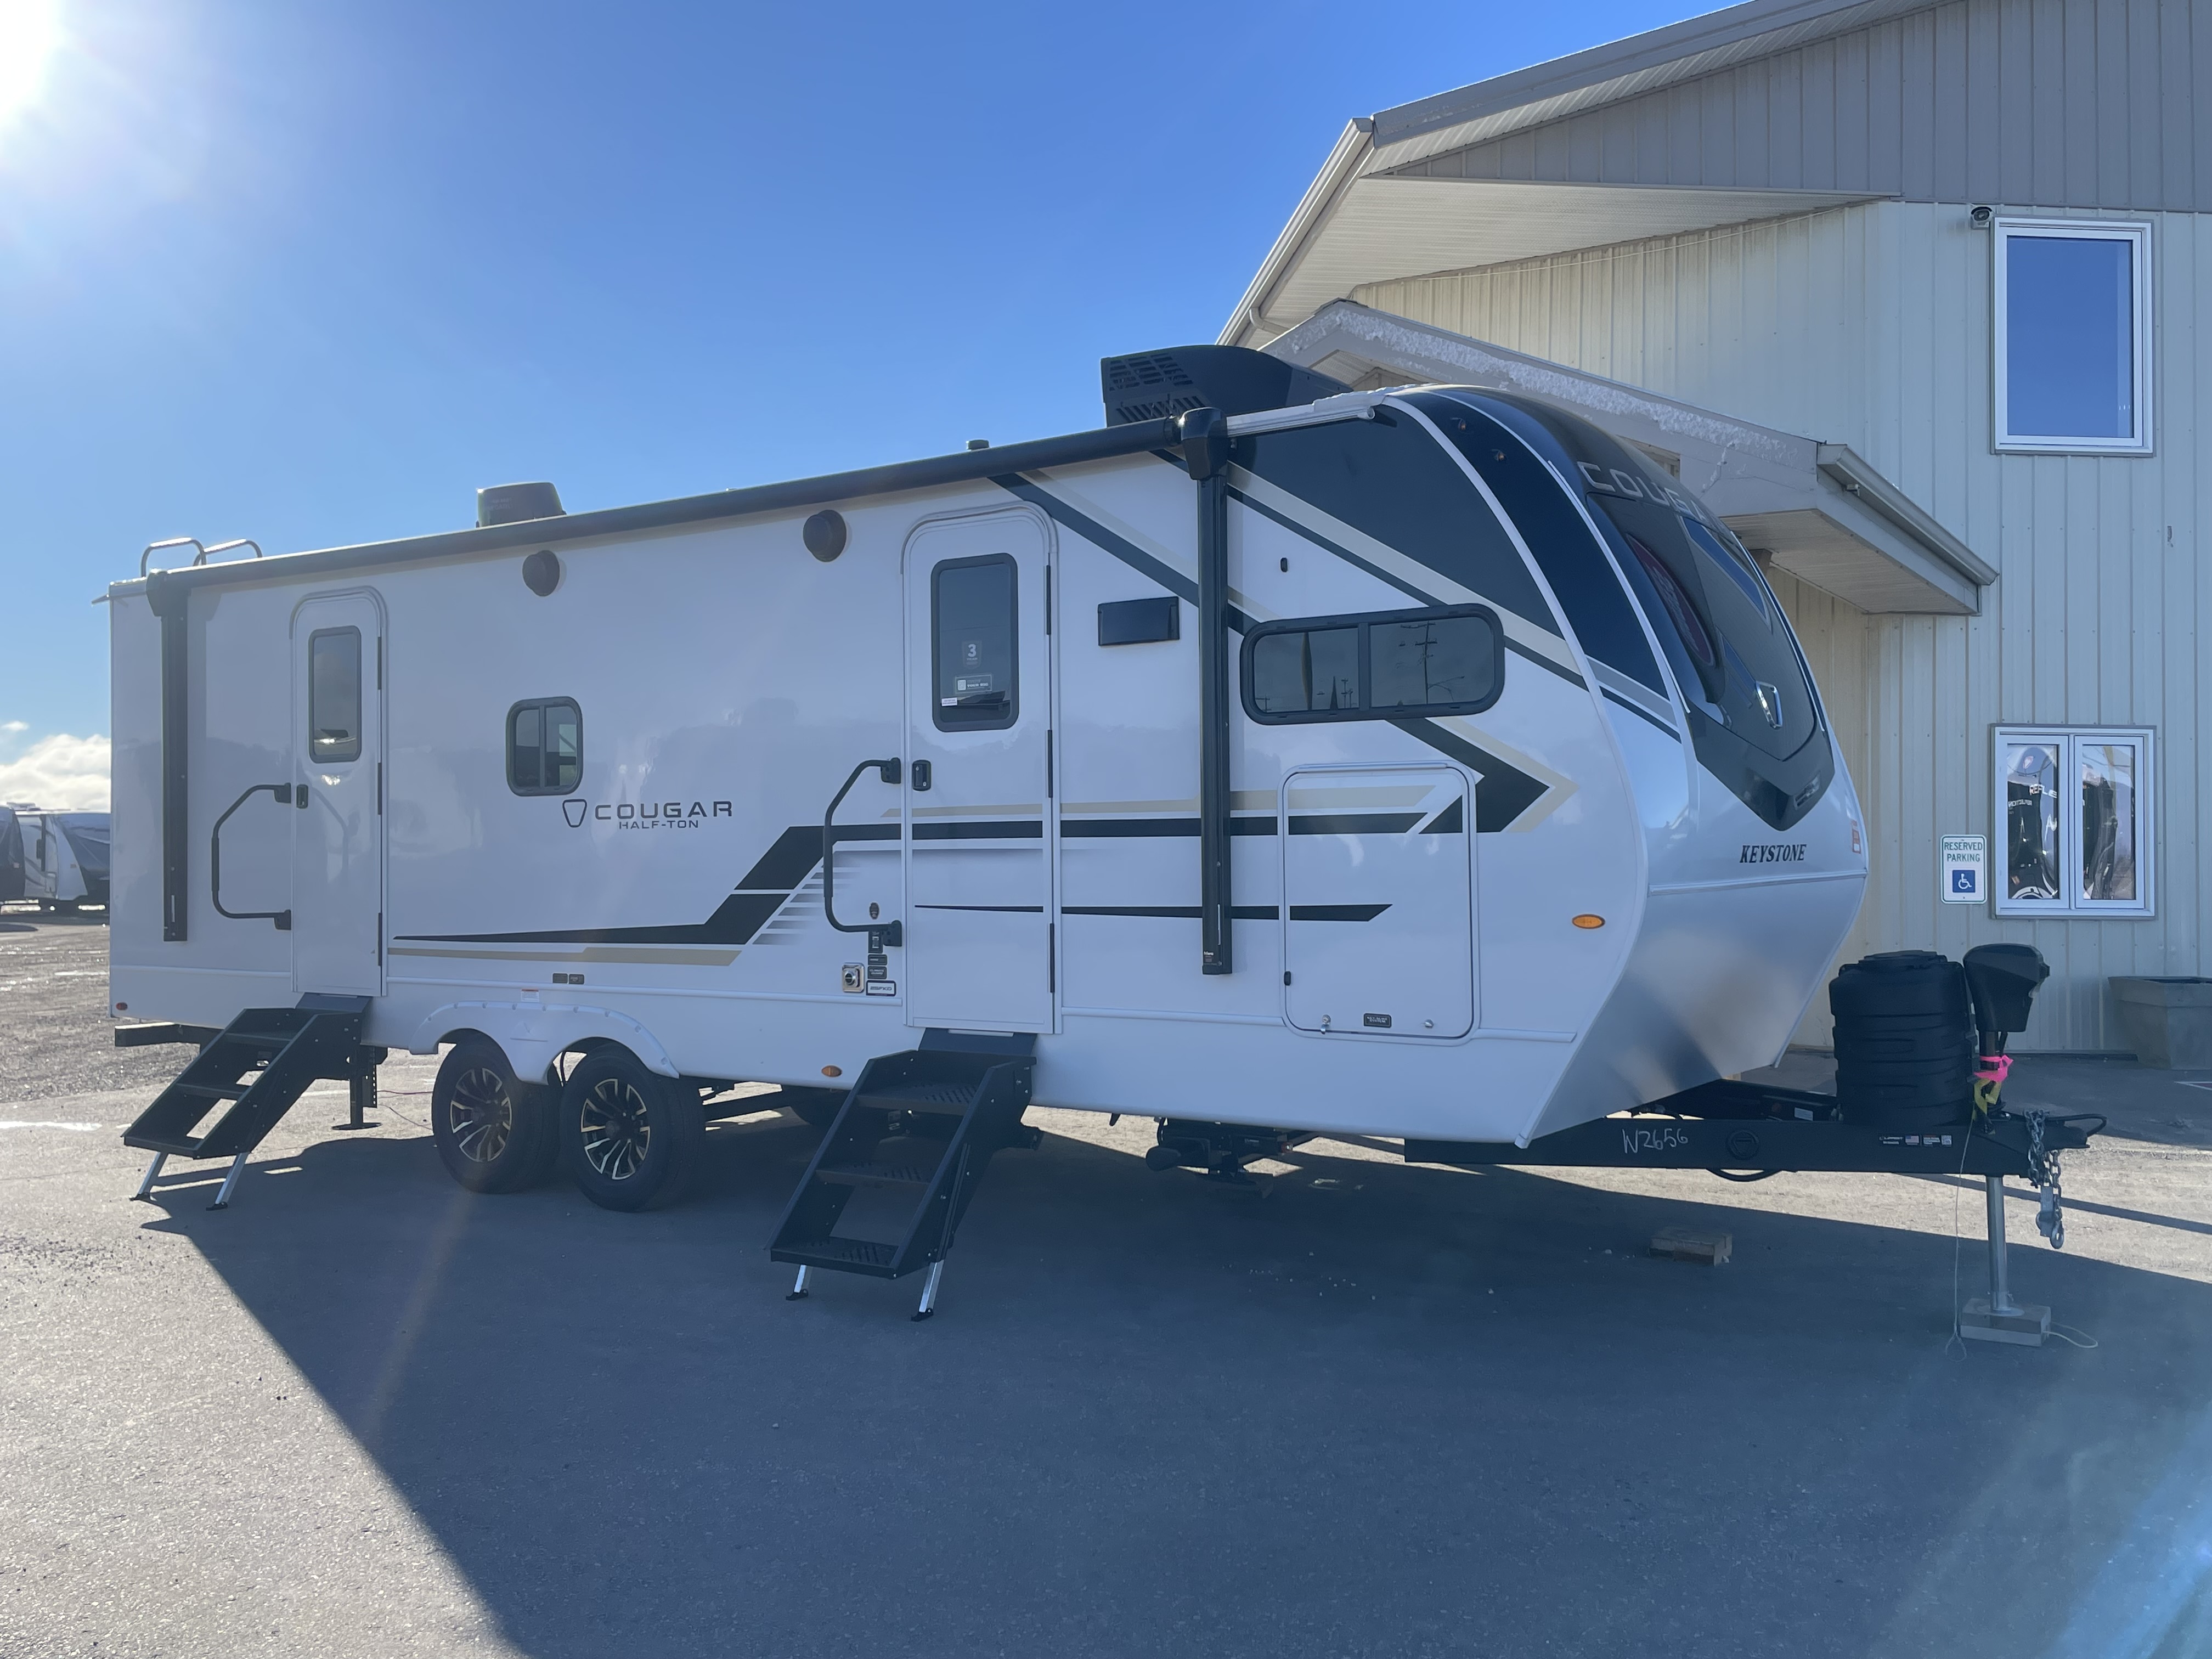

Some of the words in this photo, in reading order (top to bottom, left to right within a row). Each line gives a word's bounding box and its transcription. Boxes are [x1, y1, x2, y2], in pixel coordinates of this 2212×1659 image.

[1576, 461, 1707, 522] COUGA
[968, 644, 977, 657] 3
[595, 801, 732, 820] COUGAR
[619, 820, 698, 830] HALF-TON
[1944, 842, 1983, 850] RESERVED
[1739, 844, 1807, 864] KEYSTONE
[1946, 854, 1980, 862] PARKING
